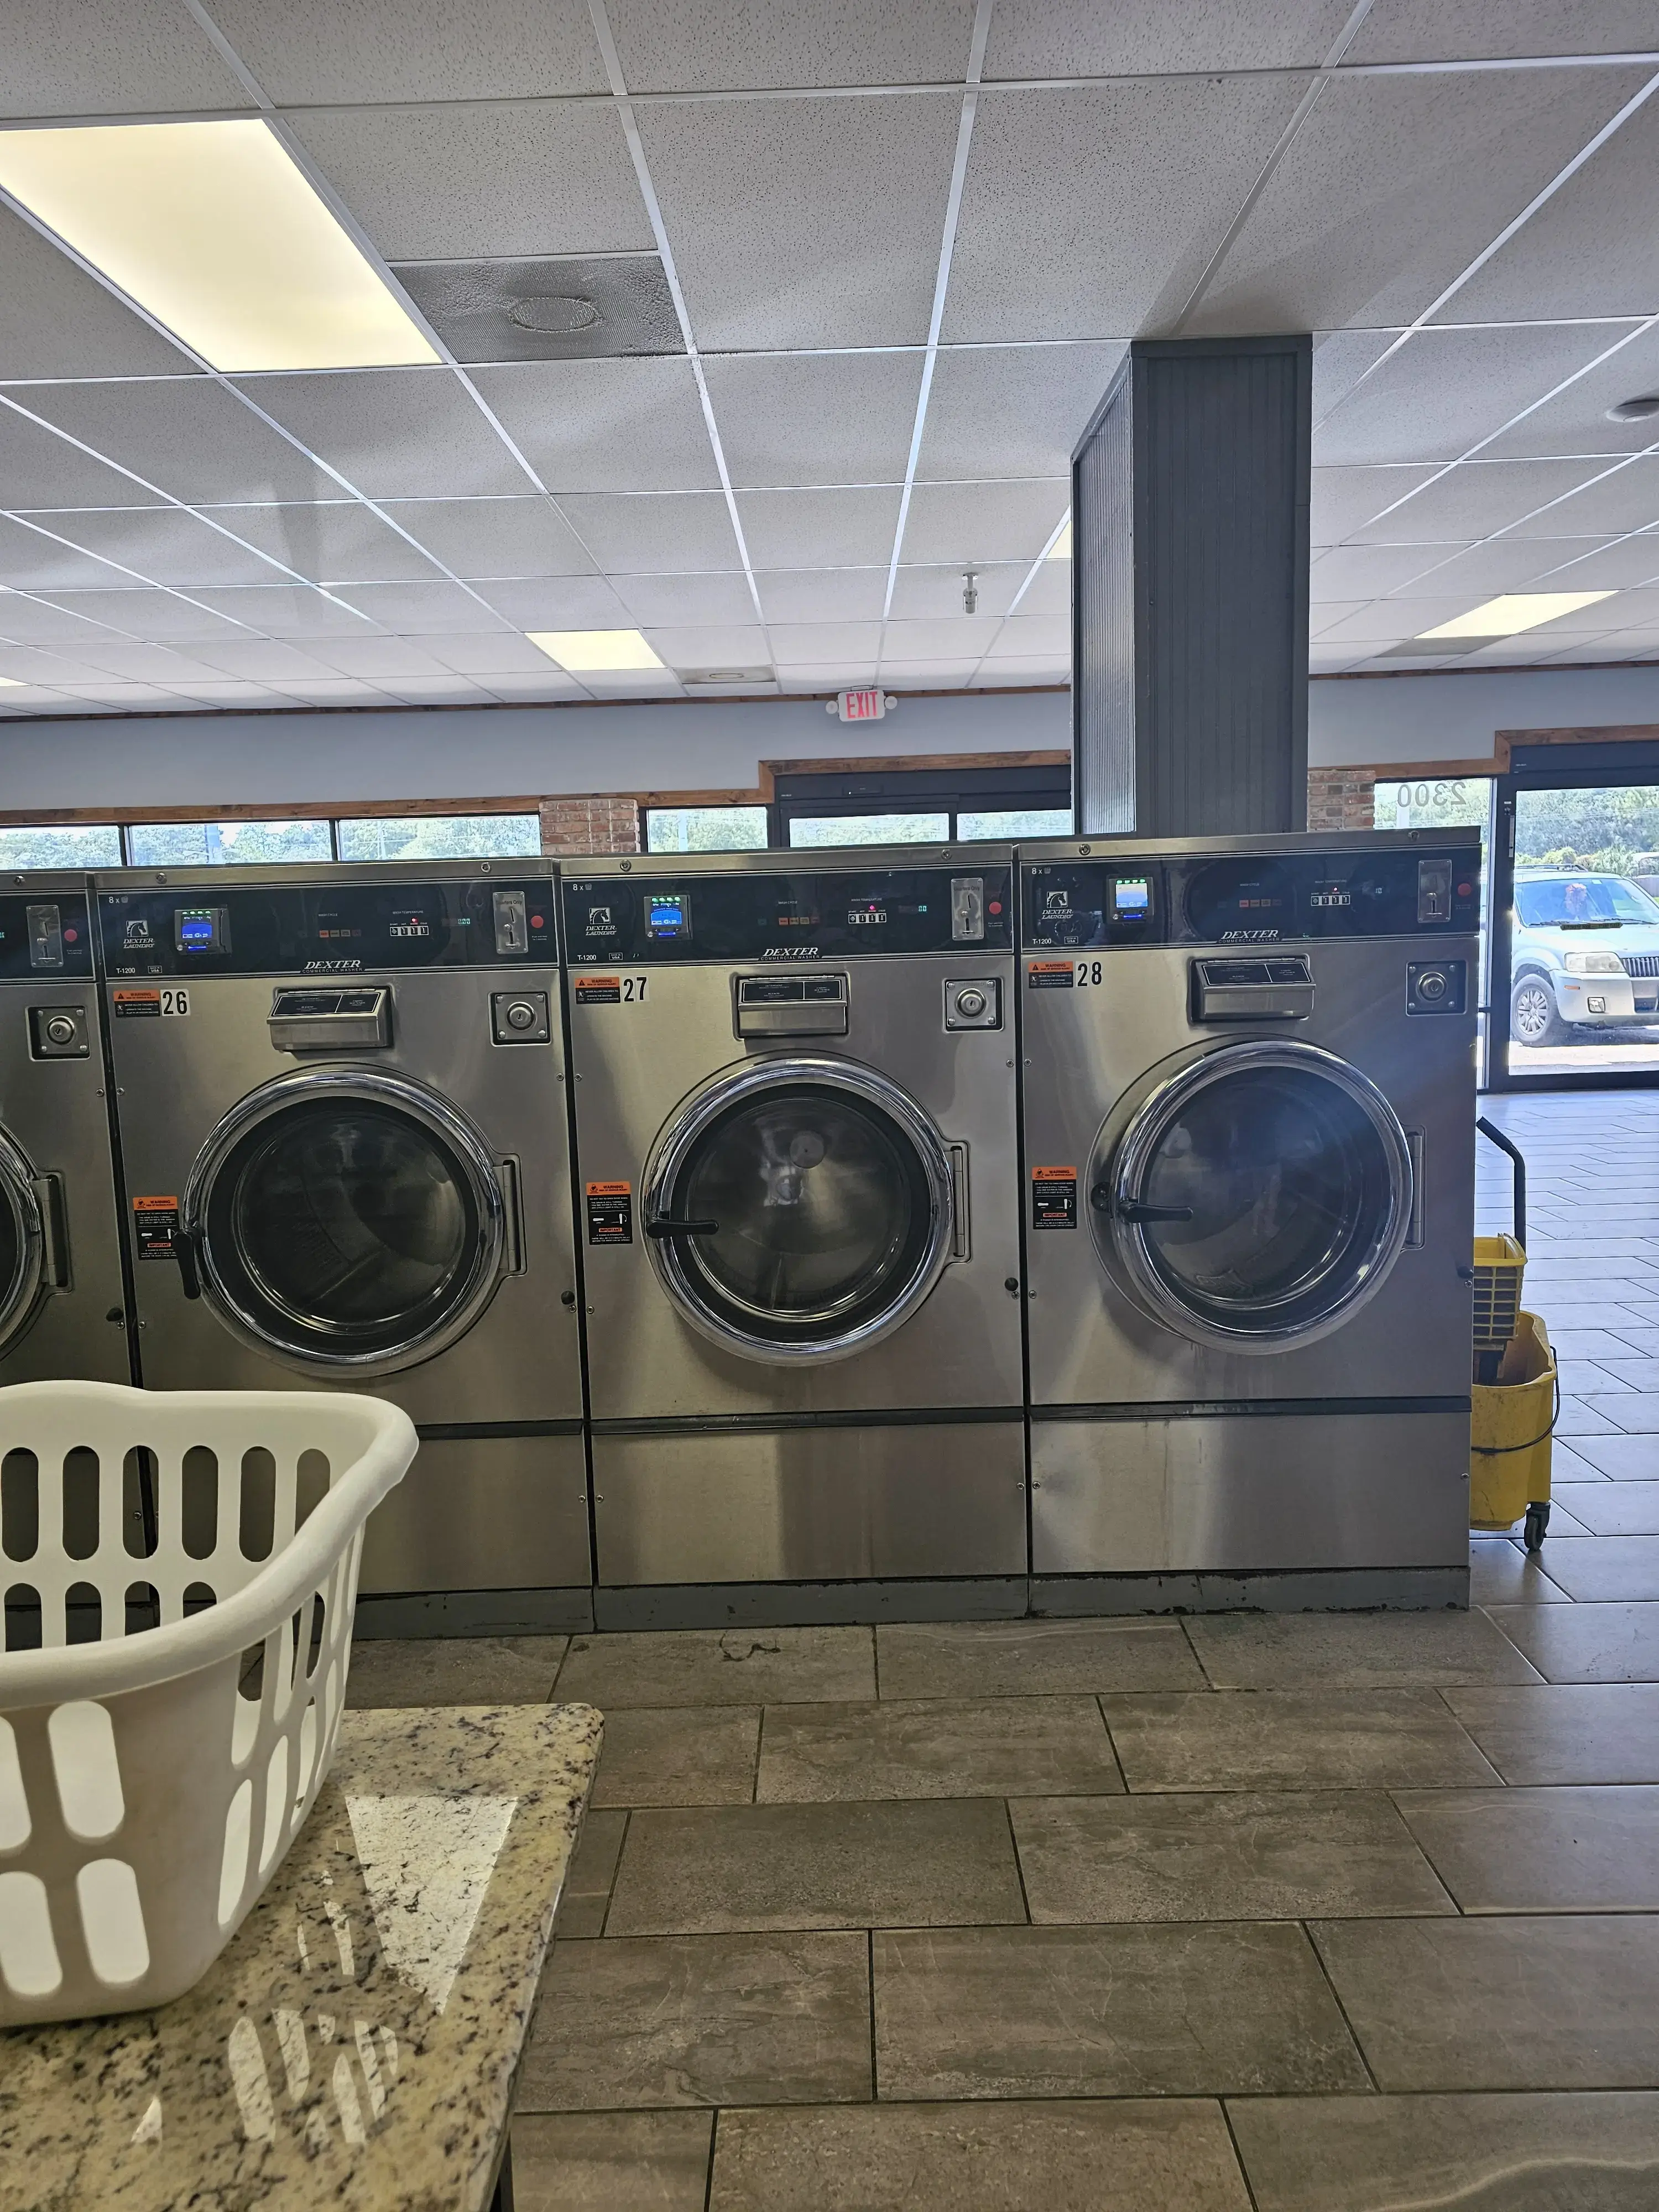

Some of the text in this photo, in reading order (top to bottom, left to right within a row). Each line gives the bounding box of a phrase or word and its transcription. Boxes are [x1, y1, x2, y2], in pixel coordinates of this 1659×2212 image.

[846, 691, 878, 719] EXIT
[1221, 930, 1279, 940] DEXTER
[304, 959, 361, 969] DEXTER
[763, 947, 818, 957] DEXTER
[1077, 962, 1102, 987] 28
[623, 977, 647, 1002] 27
[163, 991, 187, 1015] 26
